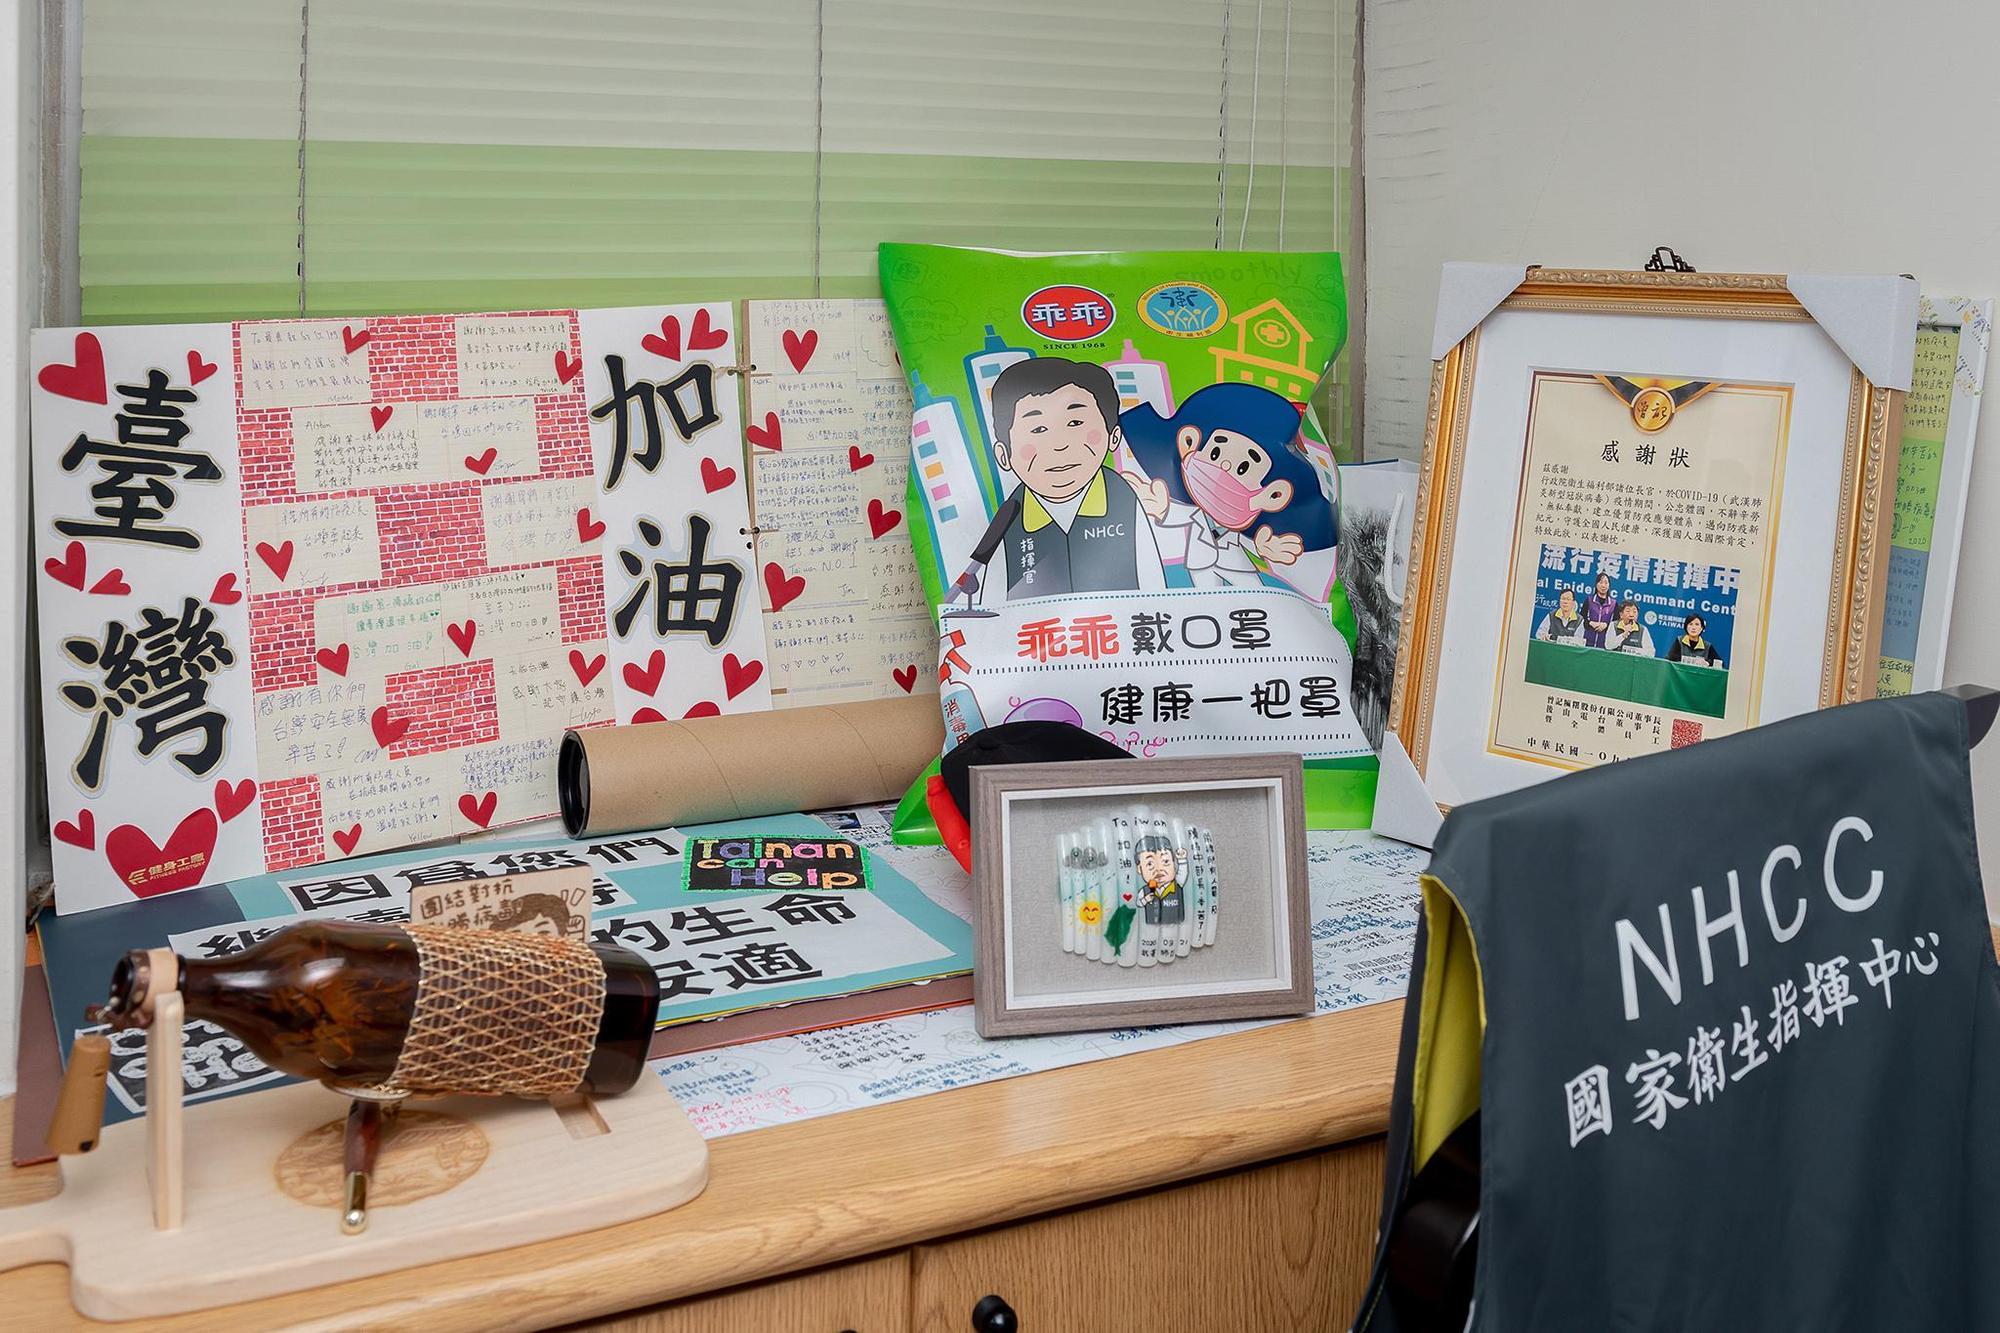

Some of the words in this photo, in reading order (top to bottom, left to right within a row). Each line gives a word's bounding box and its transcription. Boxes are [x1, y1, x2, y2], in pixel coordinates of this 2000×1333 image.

[1031, 300, 1107, 328] 乖乖
[1043, 342, 1078, 350] SINCE
[1081, 341, 1106, 349] 1968
[1600, 440, 1691, 469] 感謝狀
[590, 352, 744, 649] 加油
[1083, 522, 1126, 540] NHCC
[1908, 537, 1927, 546] 2020
[1019, 537, 1038, 585] 指揮官
[53, 367, 235, 790] 臺灣
[1554, 579, 1618, 598] Epidec
[1623, 588, 1695, 611] Command
[1700, 600, 1738, 618] Cent
[1016, 606, 1273, 664] 乖乖戴口罩
[1099, 675, 1342, 726] 健康一把罩
[1111, 816, 1168, 829] Taiwan
[696, 855, 784, 870] can
[697, 837, 854, 860] Tainan
[148, 851, 206, 876] 健身工廠
[730, 867, 858, 889] Help
[420, 878, 515, 920] 團結對抗
[1614, 816, 1884, 1021] NHCC
[1563, 931, 1941, 1149] 國家衛生指揮中心
